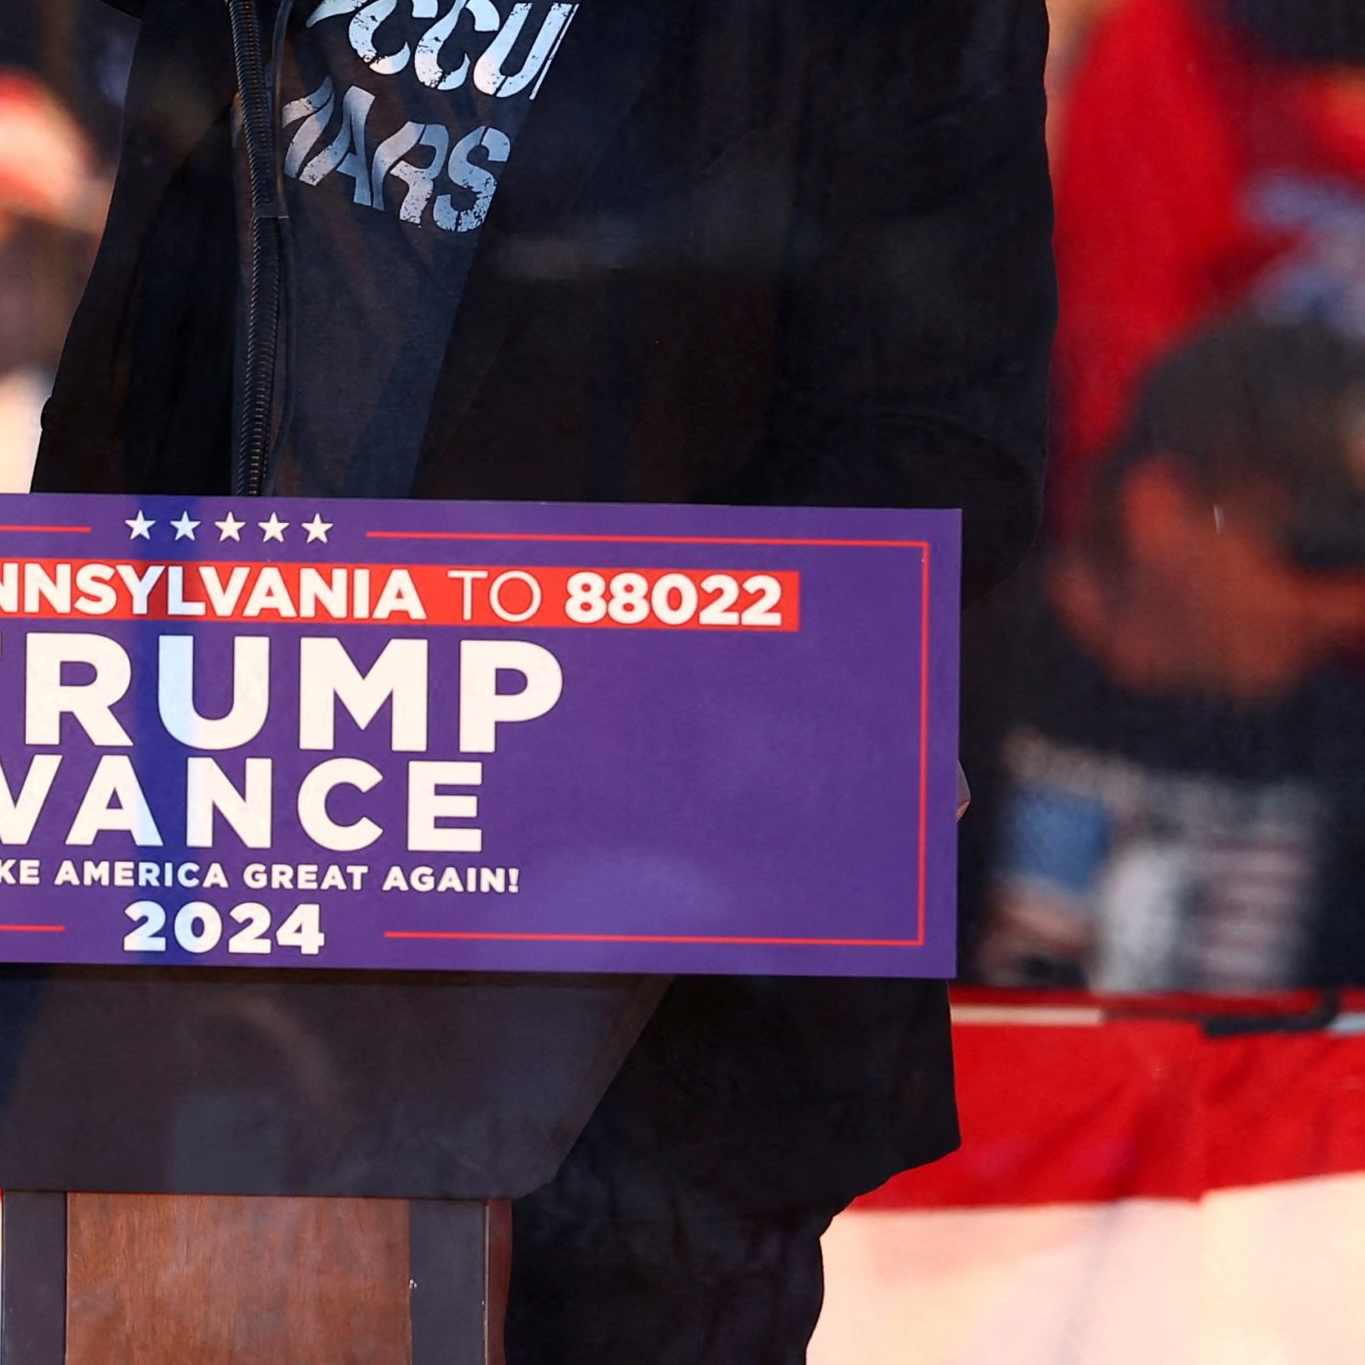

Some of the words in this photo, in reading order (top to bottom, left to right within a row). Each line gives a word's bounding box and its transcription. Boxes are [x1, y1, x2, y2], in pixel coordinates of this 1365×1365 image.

[447, 570, 542, 623] TO
[565, 572, 782, 626] 88022
[54, 860, 229, 889] AMERICA
[243, 863, 369, 891] GREAT
[382, 866, 519, 894] AGAIN!
[123, 900, 325, 955] 2024
